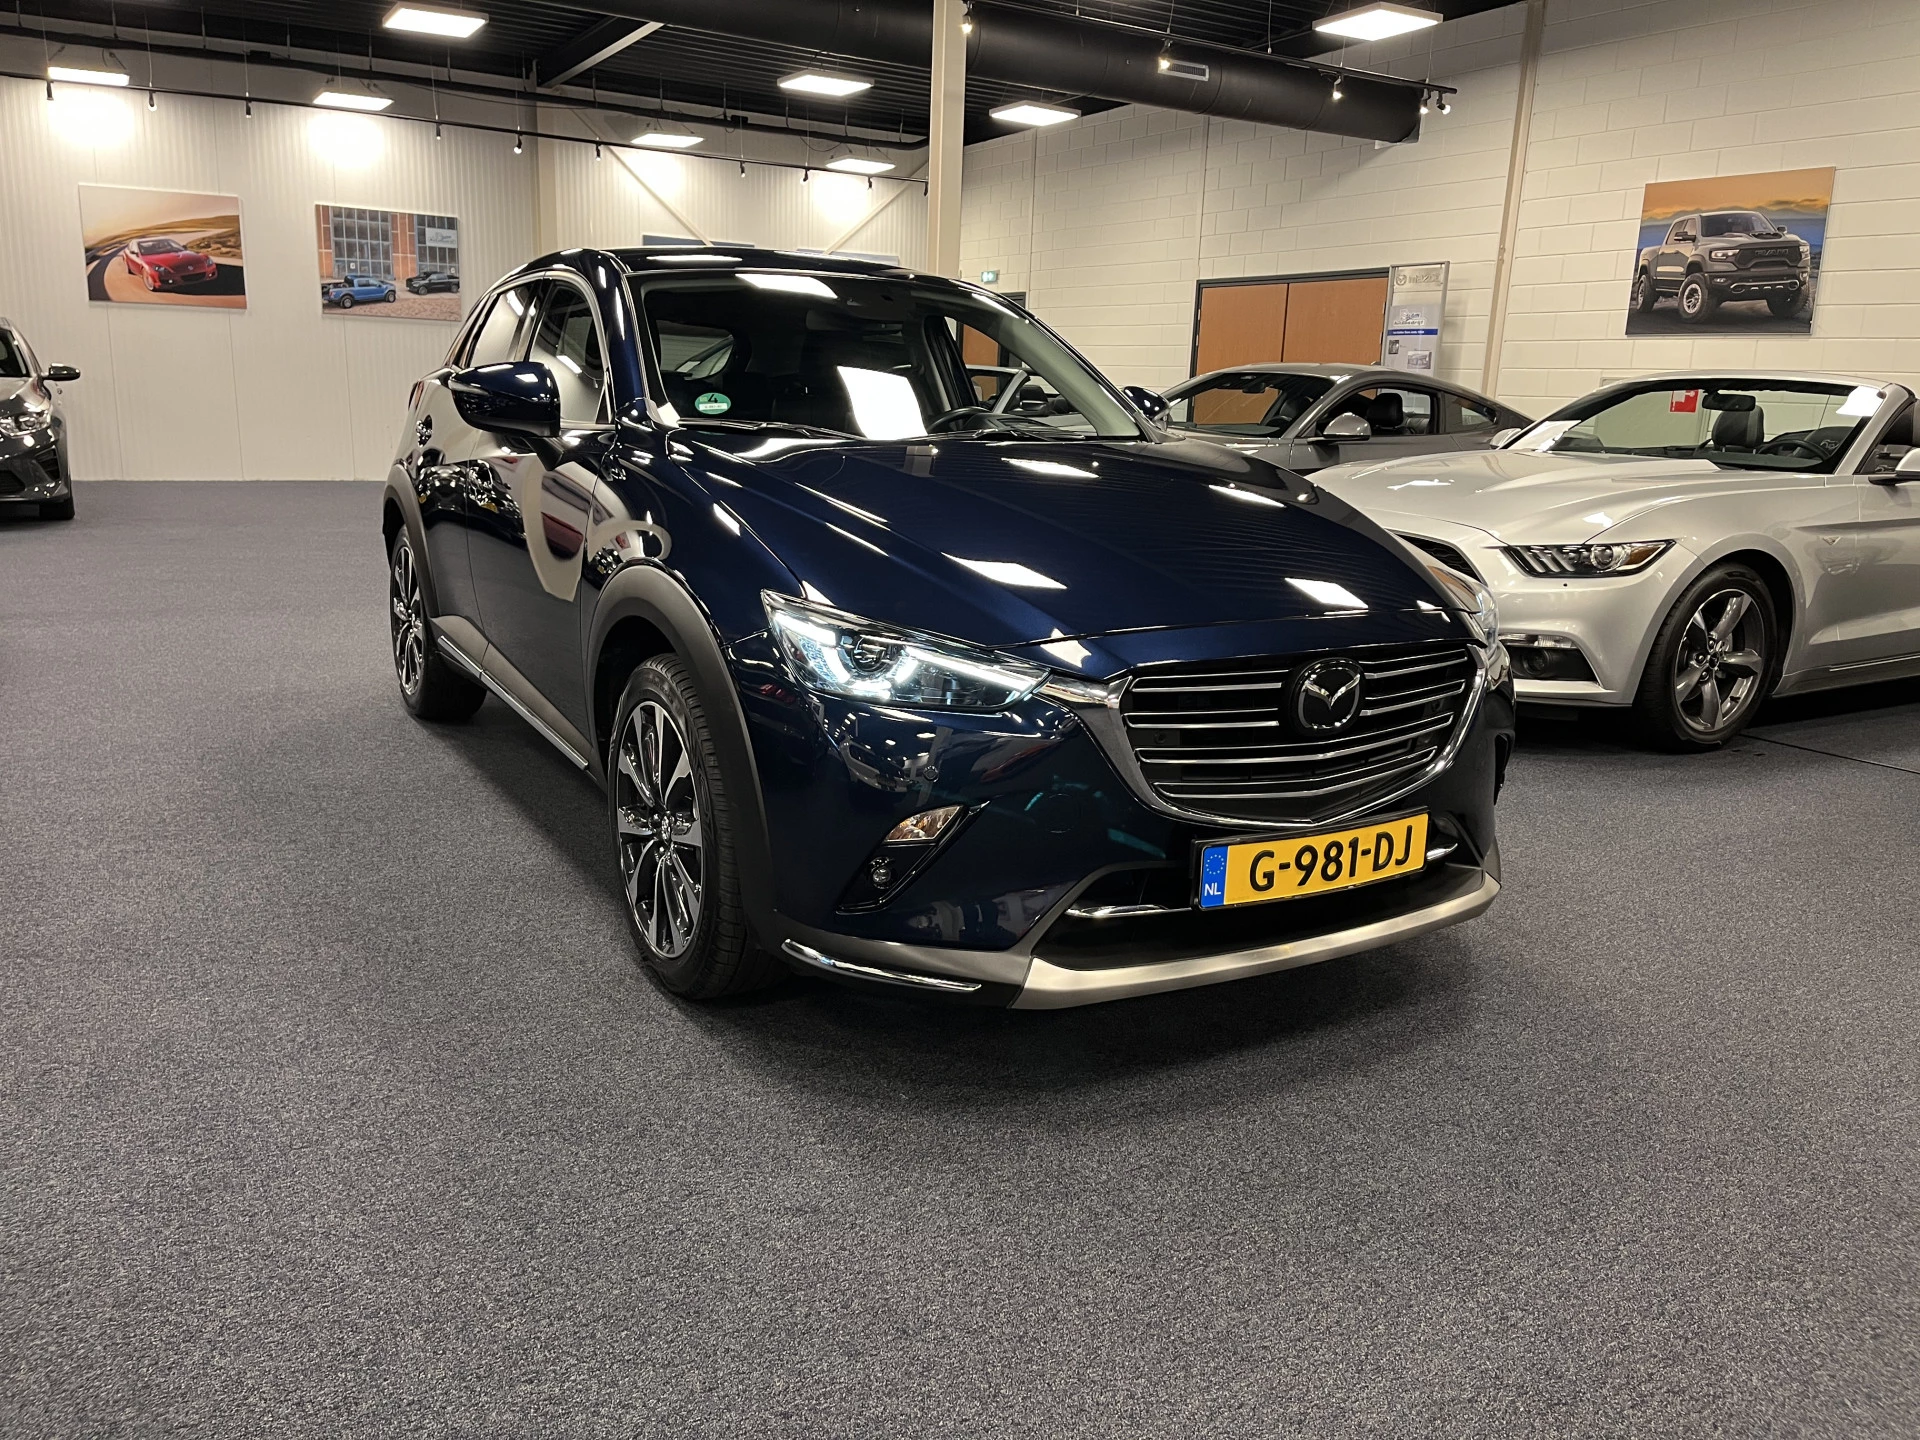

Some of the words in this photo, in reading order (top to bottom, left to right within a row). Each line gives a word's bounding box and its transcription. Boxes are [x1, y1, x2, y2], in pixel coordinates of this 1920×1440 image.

[708, 394, 718, 403] 4
[1249, 824, 1413, 892] G-981-DJ
[1204, 882, 1221, 896] NL
